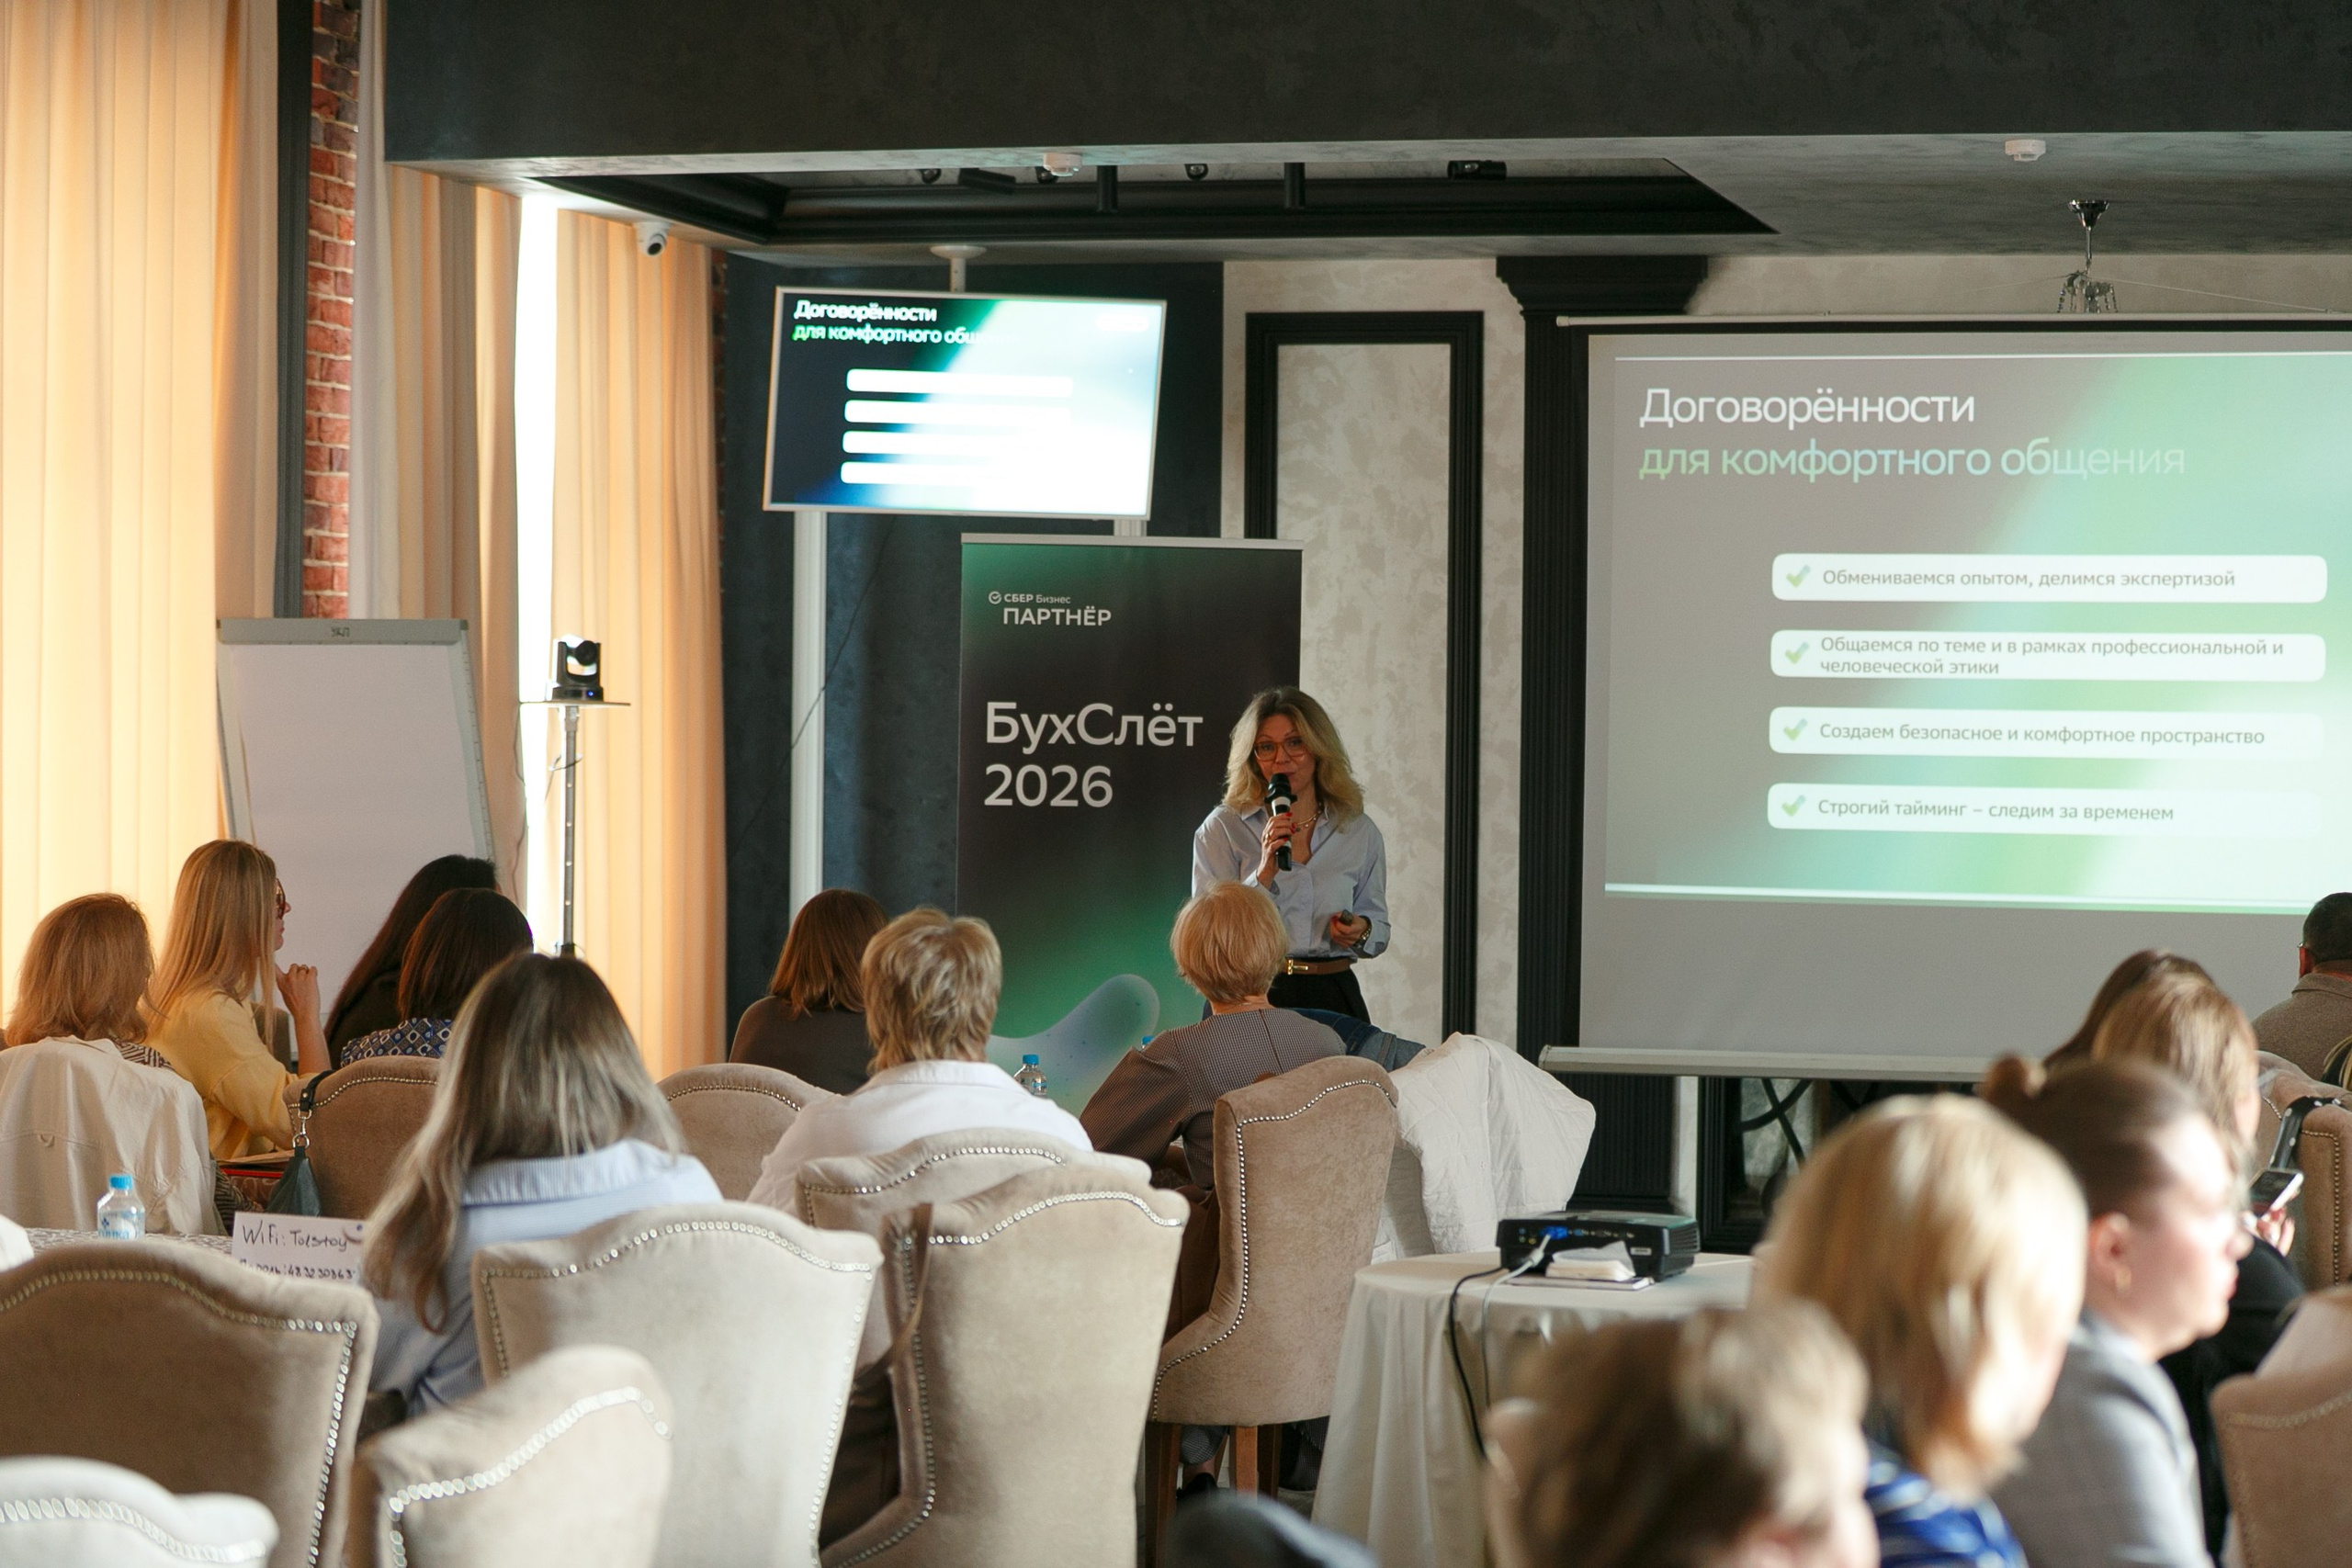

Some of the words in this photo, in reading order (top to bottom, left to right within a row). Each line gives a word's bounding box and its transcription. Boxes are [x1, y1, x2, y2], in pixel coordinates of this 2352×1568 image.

[794, 299, 937, 321] Договорённости
[793, 325, 826, 341] для
[829, 323, 942, 344] комфортного
[1639, 388, 1975, 431] Договорённости
[1639, 448, 1710, 480] для
[1722, 438, 1991, 483] комфортного
[2000, 436, 2185, 480] общения
[1822, 570, 1955, 585] Обмениваемся
[1960, 572, 2033, 588] опытом,
[2038, 572, 2115, 587] делимся
[2120, 570, 2235, 589] экспертизой
[1004, 593, 1034, 604] СБЕР
[1035, 594, 1071, 604] Бизнес
[1003, 605, 1112, 626] ПАРТНЁР
[1821, 637, 1913, 654] Общаемся
[1917, 640, 1939, 652] по
[1944, 640, 1986, 653] теме
[1991, 641, 2002, 653] и
[2007, 641, 2017, 653] в
[2021, 640, 2086, 656] рамках
[2091, 638, 2267, 657] профессиональной
[2273, 642, 2284, 655] и
[1820, 659, 1944, 673] человеческой
[1949, 661, 1999, 674] этики
[986, 701, 1204, 755] БухСлёт
[1820, 724, 1894, 740] Создаем
[1899, 724, 2003, 740] безопасное
[2007, 728, 2018, 740] и
[2023, 726, 2135, 745] комфортное
[2140, 728, 2265, 746] пространство
[984, 763, 1114, 807] 2026
[1818, 799, 1890, 817] Строгий
[1894, 800, 1967, 816] тайминг
[1988, 805, 2054, 819] следим
[2059, 806, 2078, 819] за
[2083, 807, 2174, 822] временем
